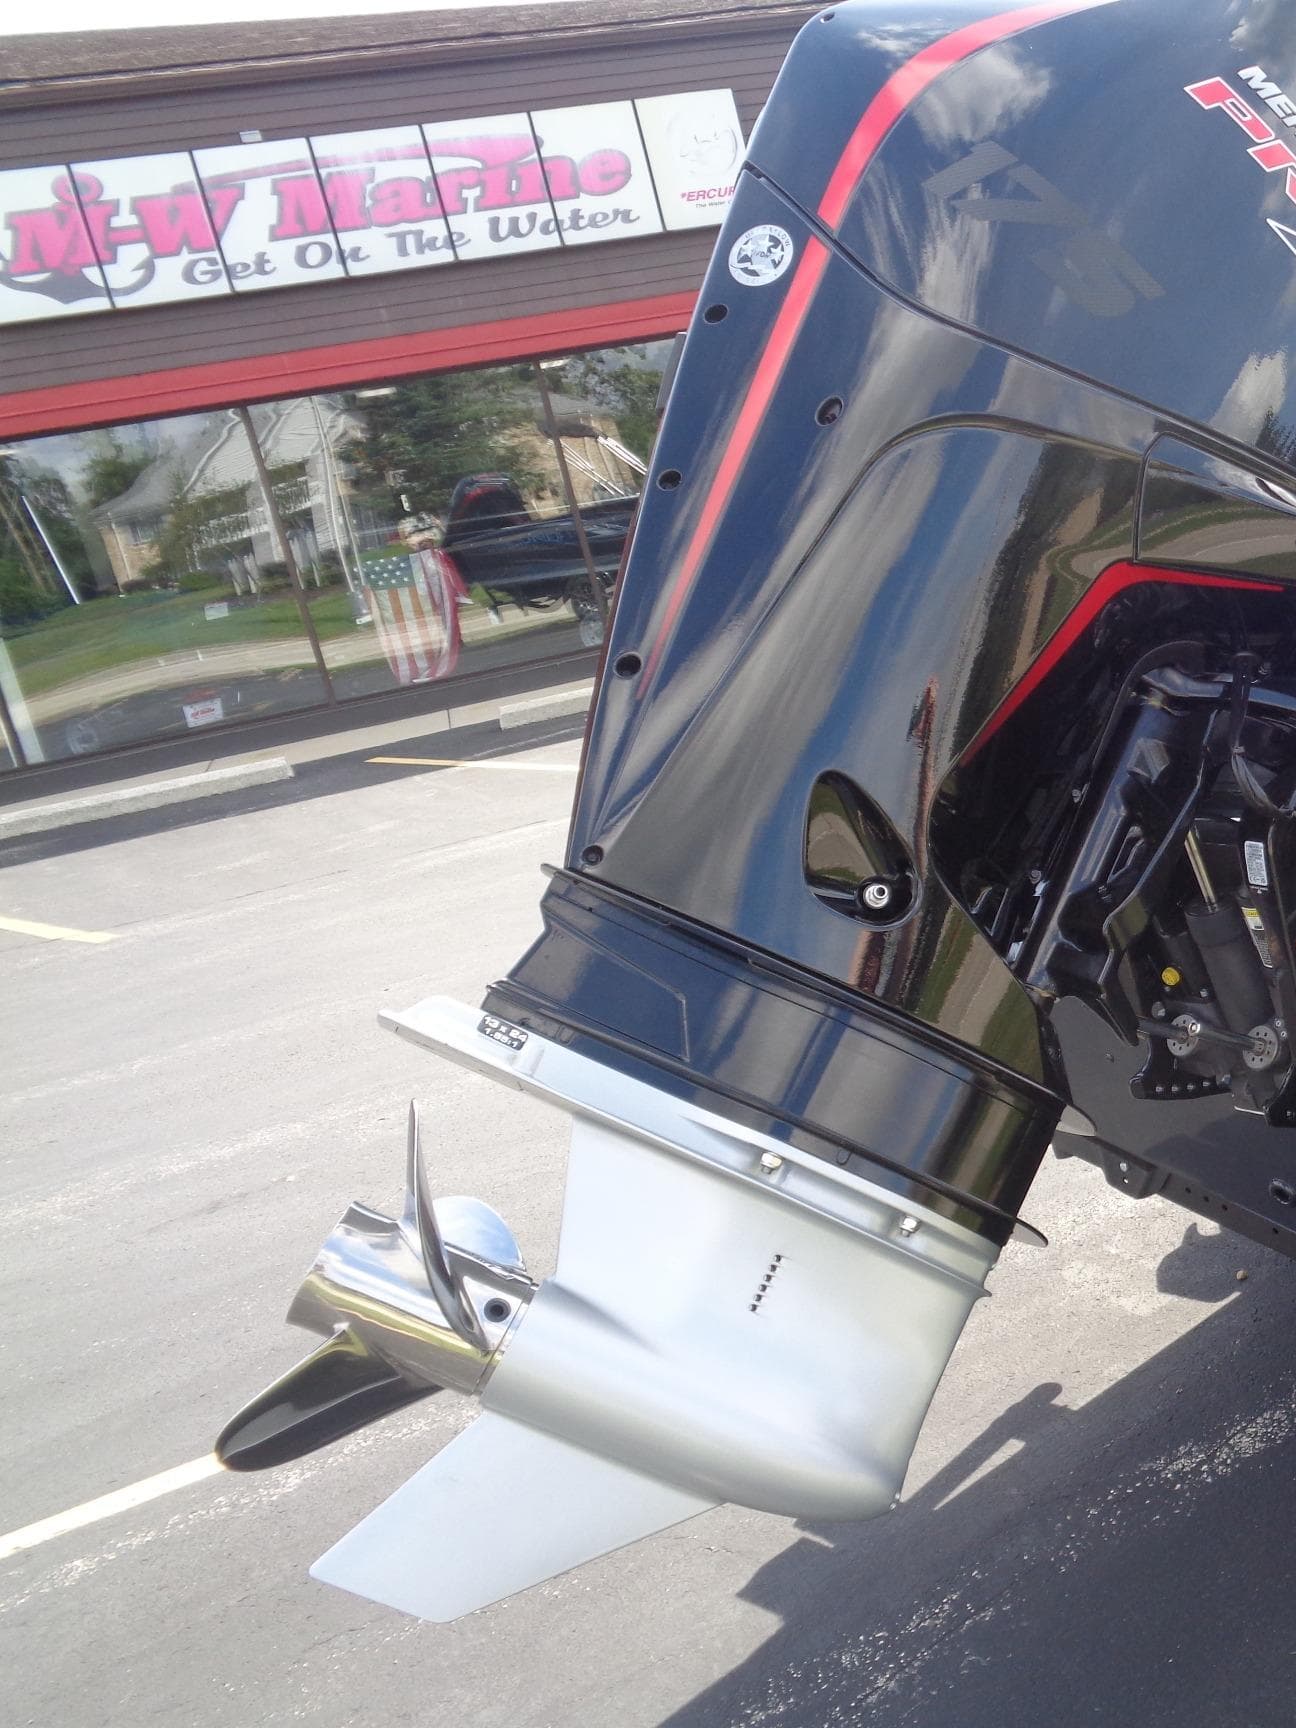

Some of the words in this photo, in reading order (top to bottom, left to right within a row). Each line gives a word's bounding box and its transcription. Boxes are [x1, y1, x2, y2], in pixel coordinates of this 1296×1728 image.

[4, 182, 246, 277] M-W
[268, 149, 632, 241] Marine
[182, 251, 277, 286] Get
[295, 241, 371, 269] On
[385, 228, 471, 257] The
[487, 205, 640, 243] Water
